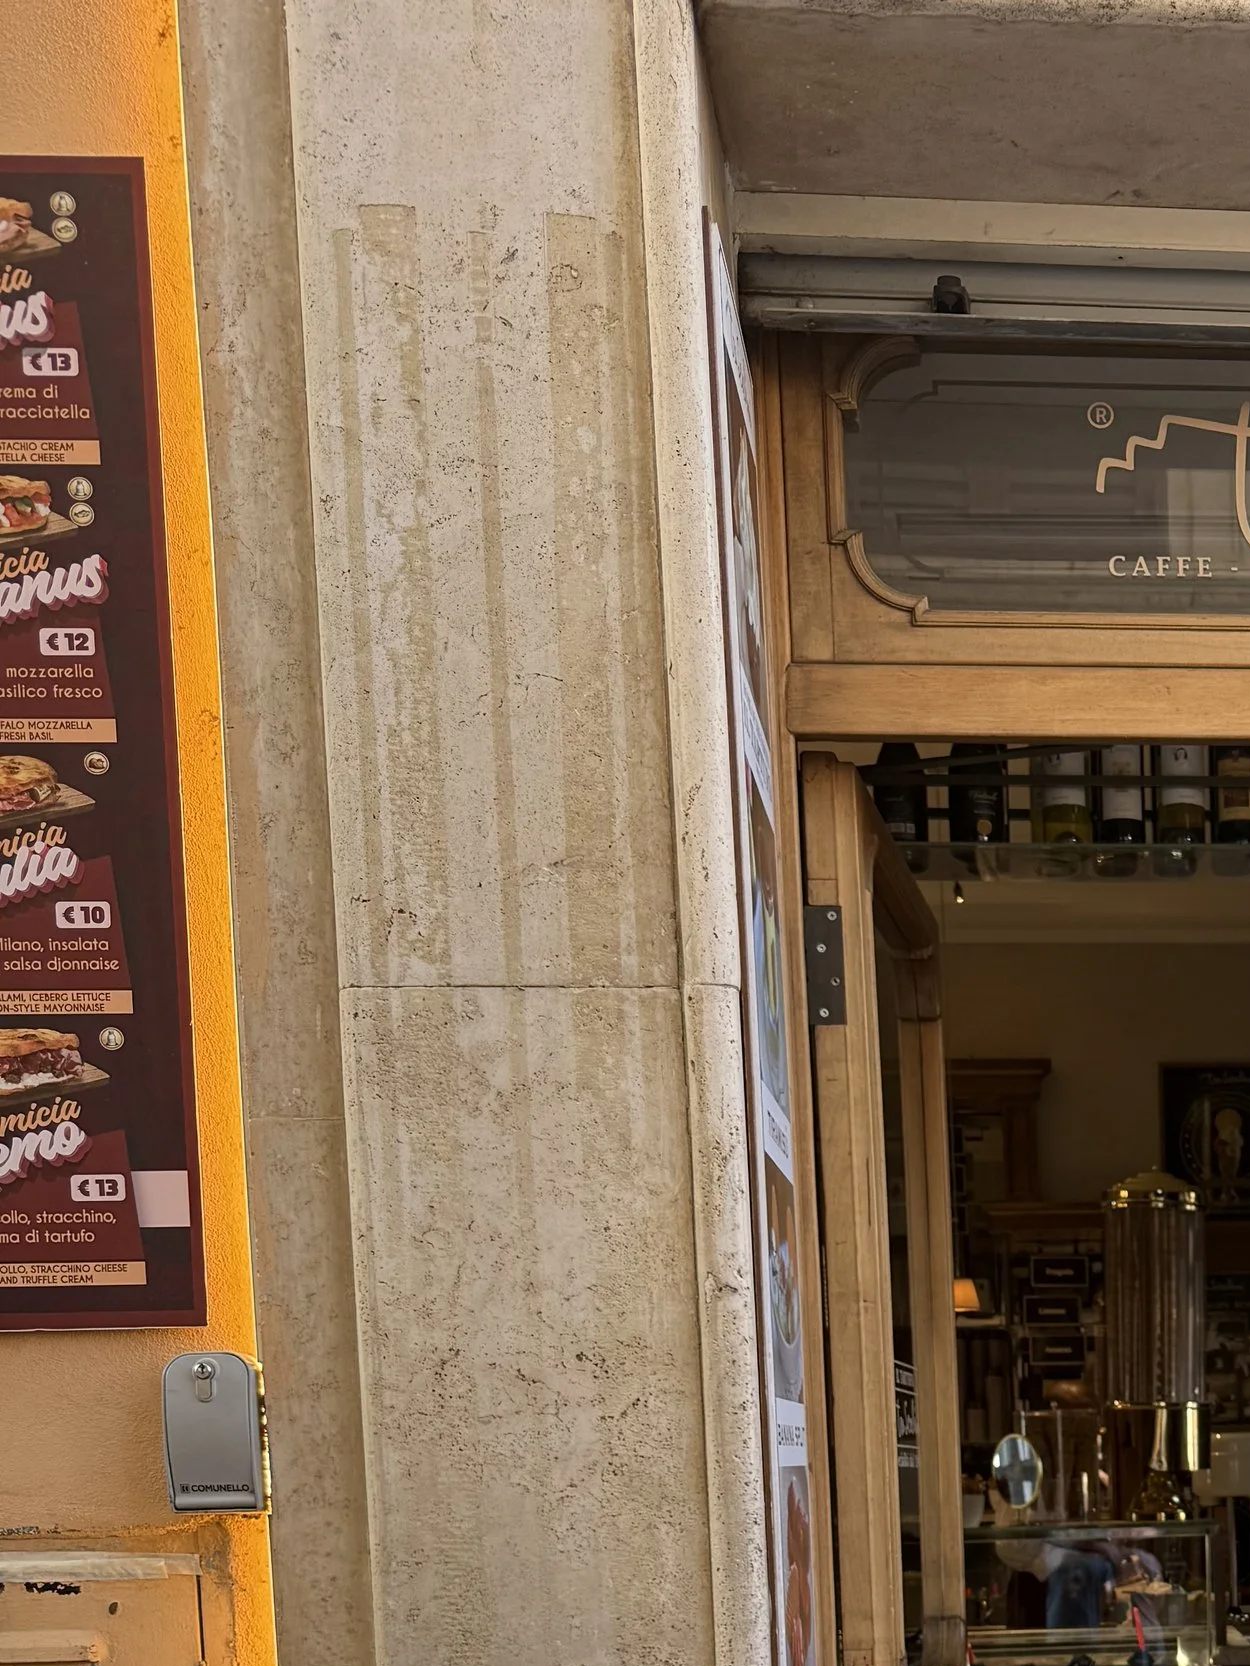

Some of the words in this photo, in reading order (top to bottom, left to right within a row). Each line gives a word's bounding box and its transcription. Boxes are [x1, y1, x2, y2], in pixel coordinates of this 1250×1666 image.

[43, 384, 58, 399] di
[0, 442, 38, 452] TACHIO
[41, 442, 75, 452] CREAM
[30, 453, 66, 462] CHEESE
[1108, 555, 1213, 578] CAFFE
[6, 663, 94, 678] mozzarella
[53, 684, 103, 698] fresco
[28, 721, 93, 730] MOZZARELLA
[29, 731, 54, 741] BASIL
[0, 937, 44, 953] ilano,
[49, 937, 109, 951] insalata
[4, 956, 42, 971] salsa
[47, 956, 120, 972] djonnaise
[0, 993, 26, 1004] LAMI,
[29, 993, 69, 1002] ICEBERG
[71, 992, 111, 1002] LETTUCE
[43, 1003, 105, 1013] MAYONNAISE
[36, 1209, 117, 1225] stracchino,
[25, 1229, 40, 1244] di
[44, 1229, 95, 1244] tartufo
[30, 1265, 91, 1275] STRACCHINO
[93, 1264, 128, 1273] CHEESE
[20, 1275, 58, 1285] TRUFFLE
[60, 1274, 94, 1284] CREAM
[191, 1484, 250, 1492] COMUNELLO
